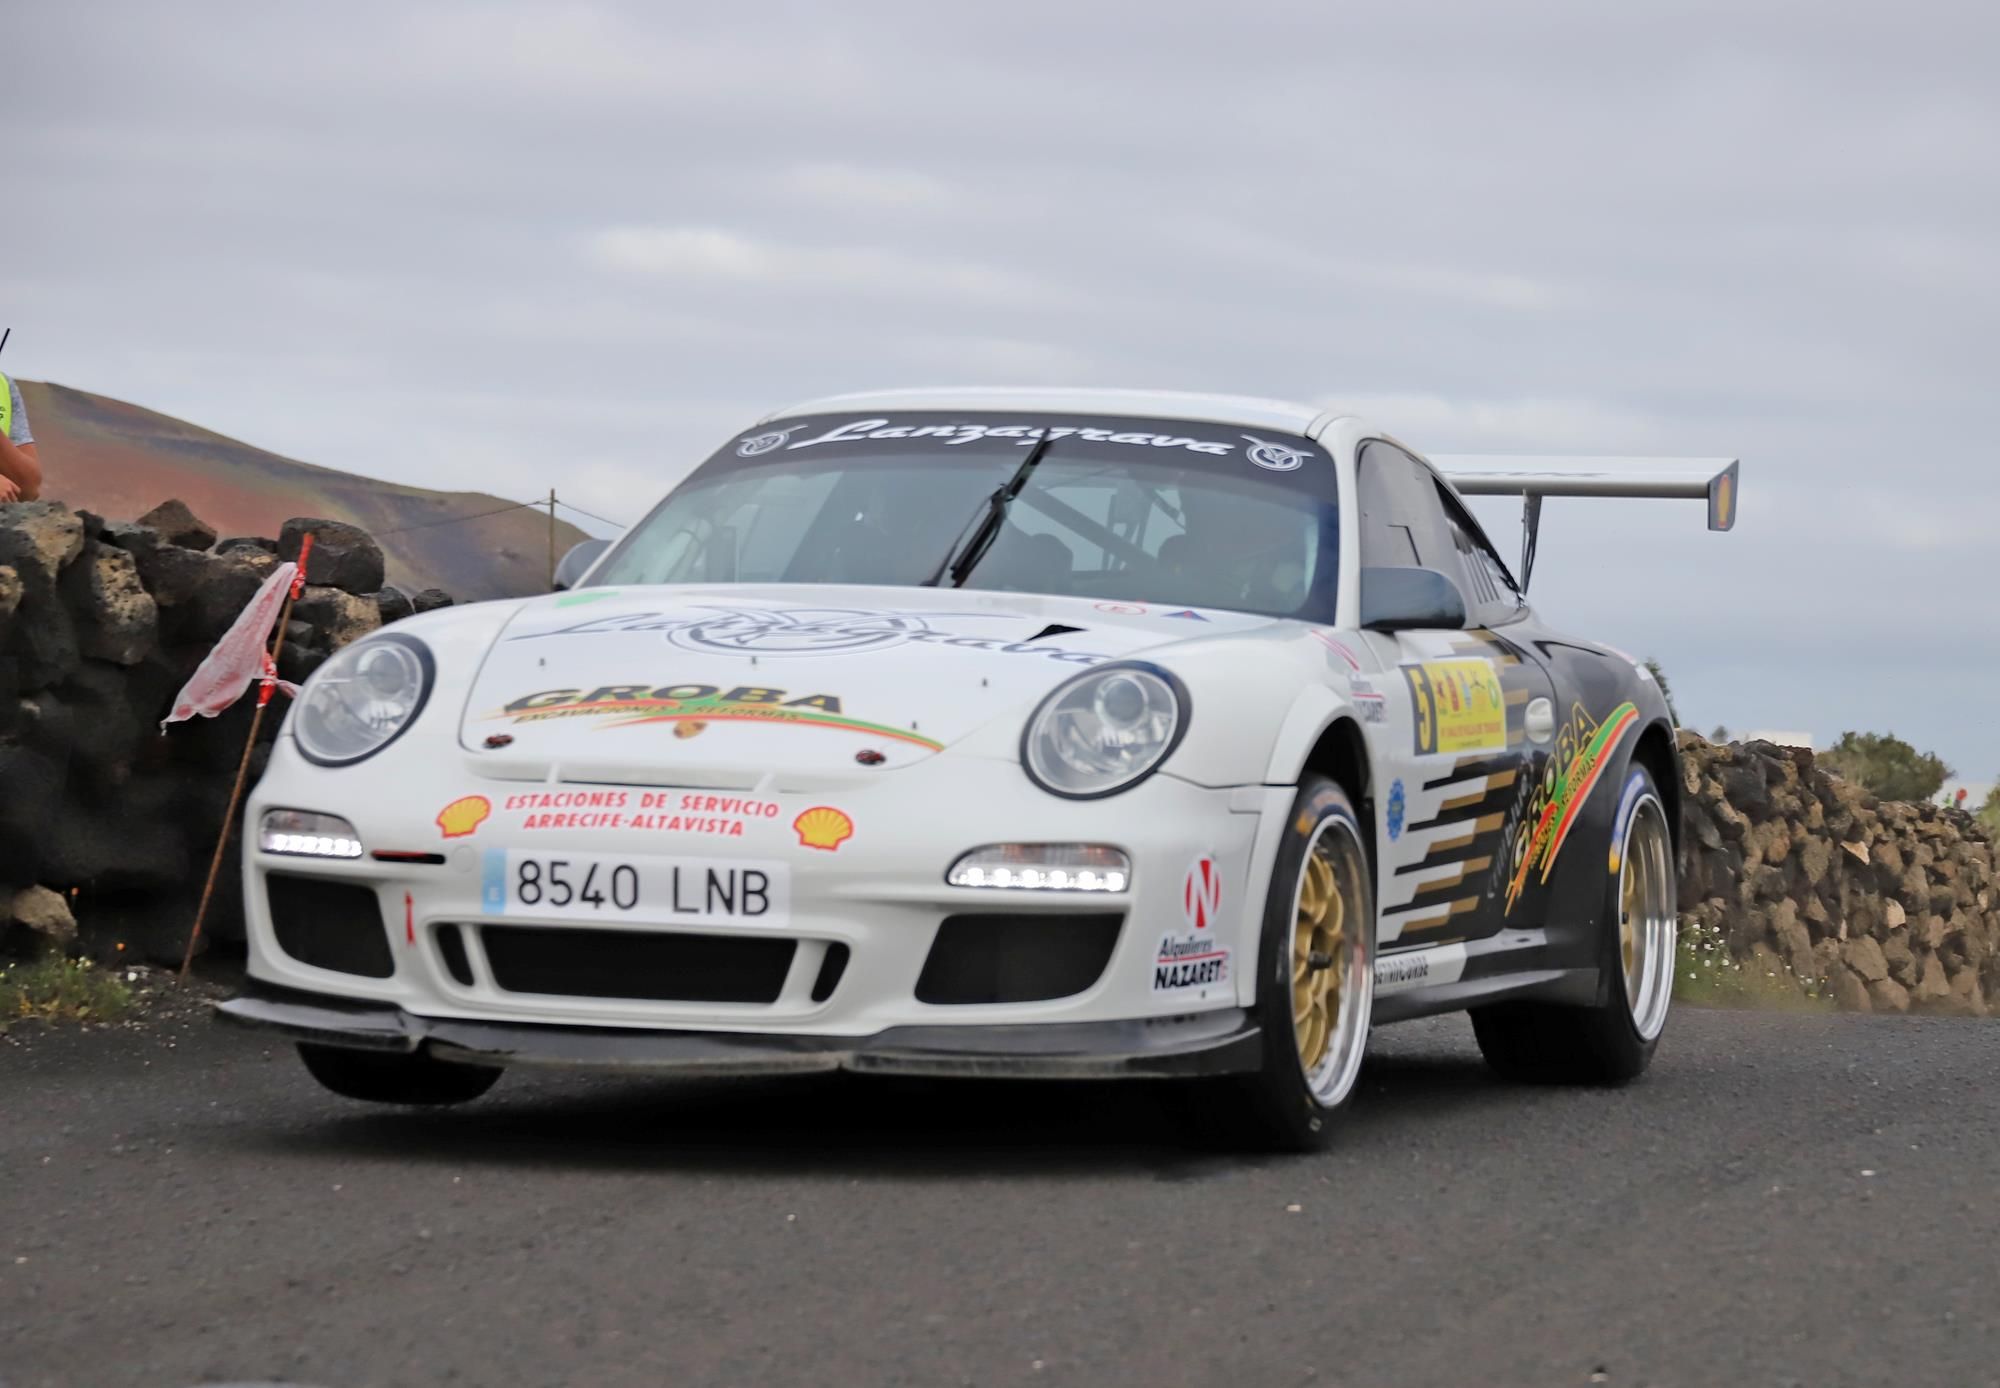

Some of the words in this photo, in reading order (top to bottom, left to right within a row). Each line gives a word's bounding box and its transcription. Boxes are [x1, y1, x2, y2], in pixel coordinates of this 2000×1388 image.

[787, 418, 1235, 456] Lanzagrava
[504, 684, 842, 714] GROBA
[1407, 668, 1432, 752] 5
[505, 791, 628, 811] ESTACIONES
[640, 793, 668, 810] DE
[680, 795, 780, 818] SERVICIO
[523, 812, 744, 837] ARRECIFE-ALTAVISTA
[517, 858, 639, 910] 8540
[672, 866, 770, 916] LNB
[1154, 959, 1222, 990] NAZARET
